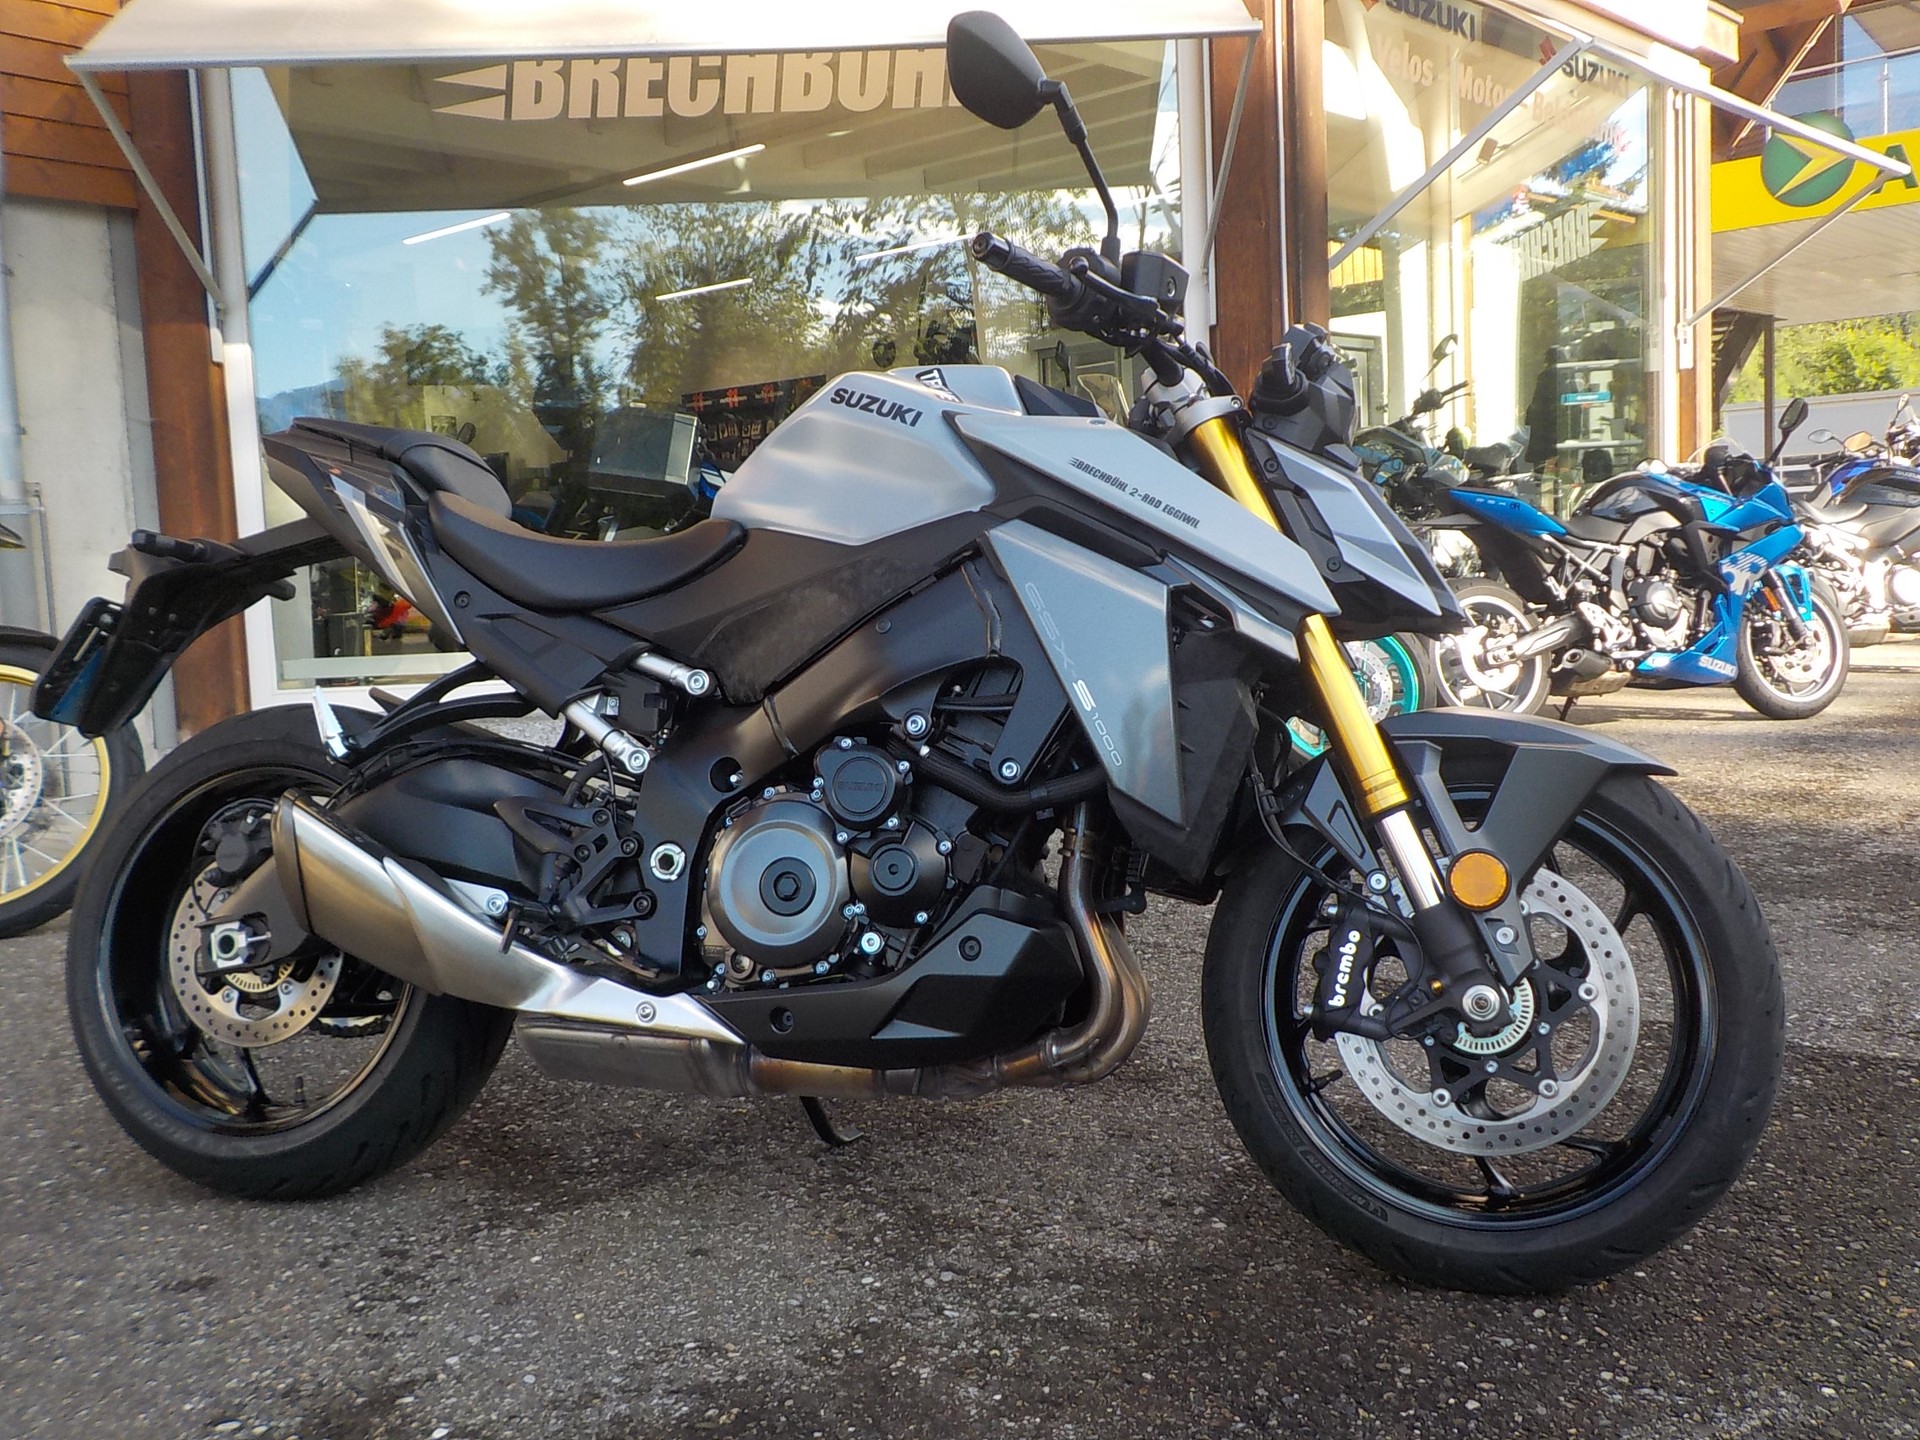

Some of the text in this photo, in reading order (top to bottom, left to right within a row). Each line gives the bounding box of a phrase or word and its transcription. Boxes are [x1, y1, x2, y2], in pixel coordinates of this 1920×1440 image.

[830, 387, 923, 427] SUZUKI
[1077, 460, 1200, 529] BRECHBÜHL 2-RAD EGGIWIL
[1328, 930, 1361, 1007] brembo
